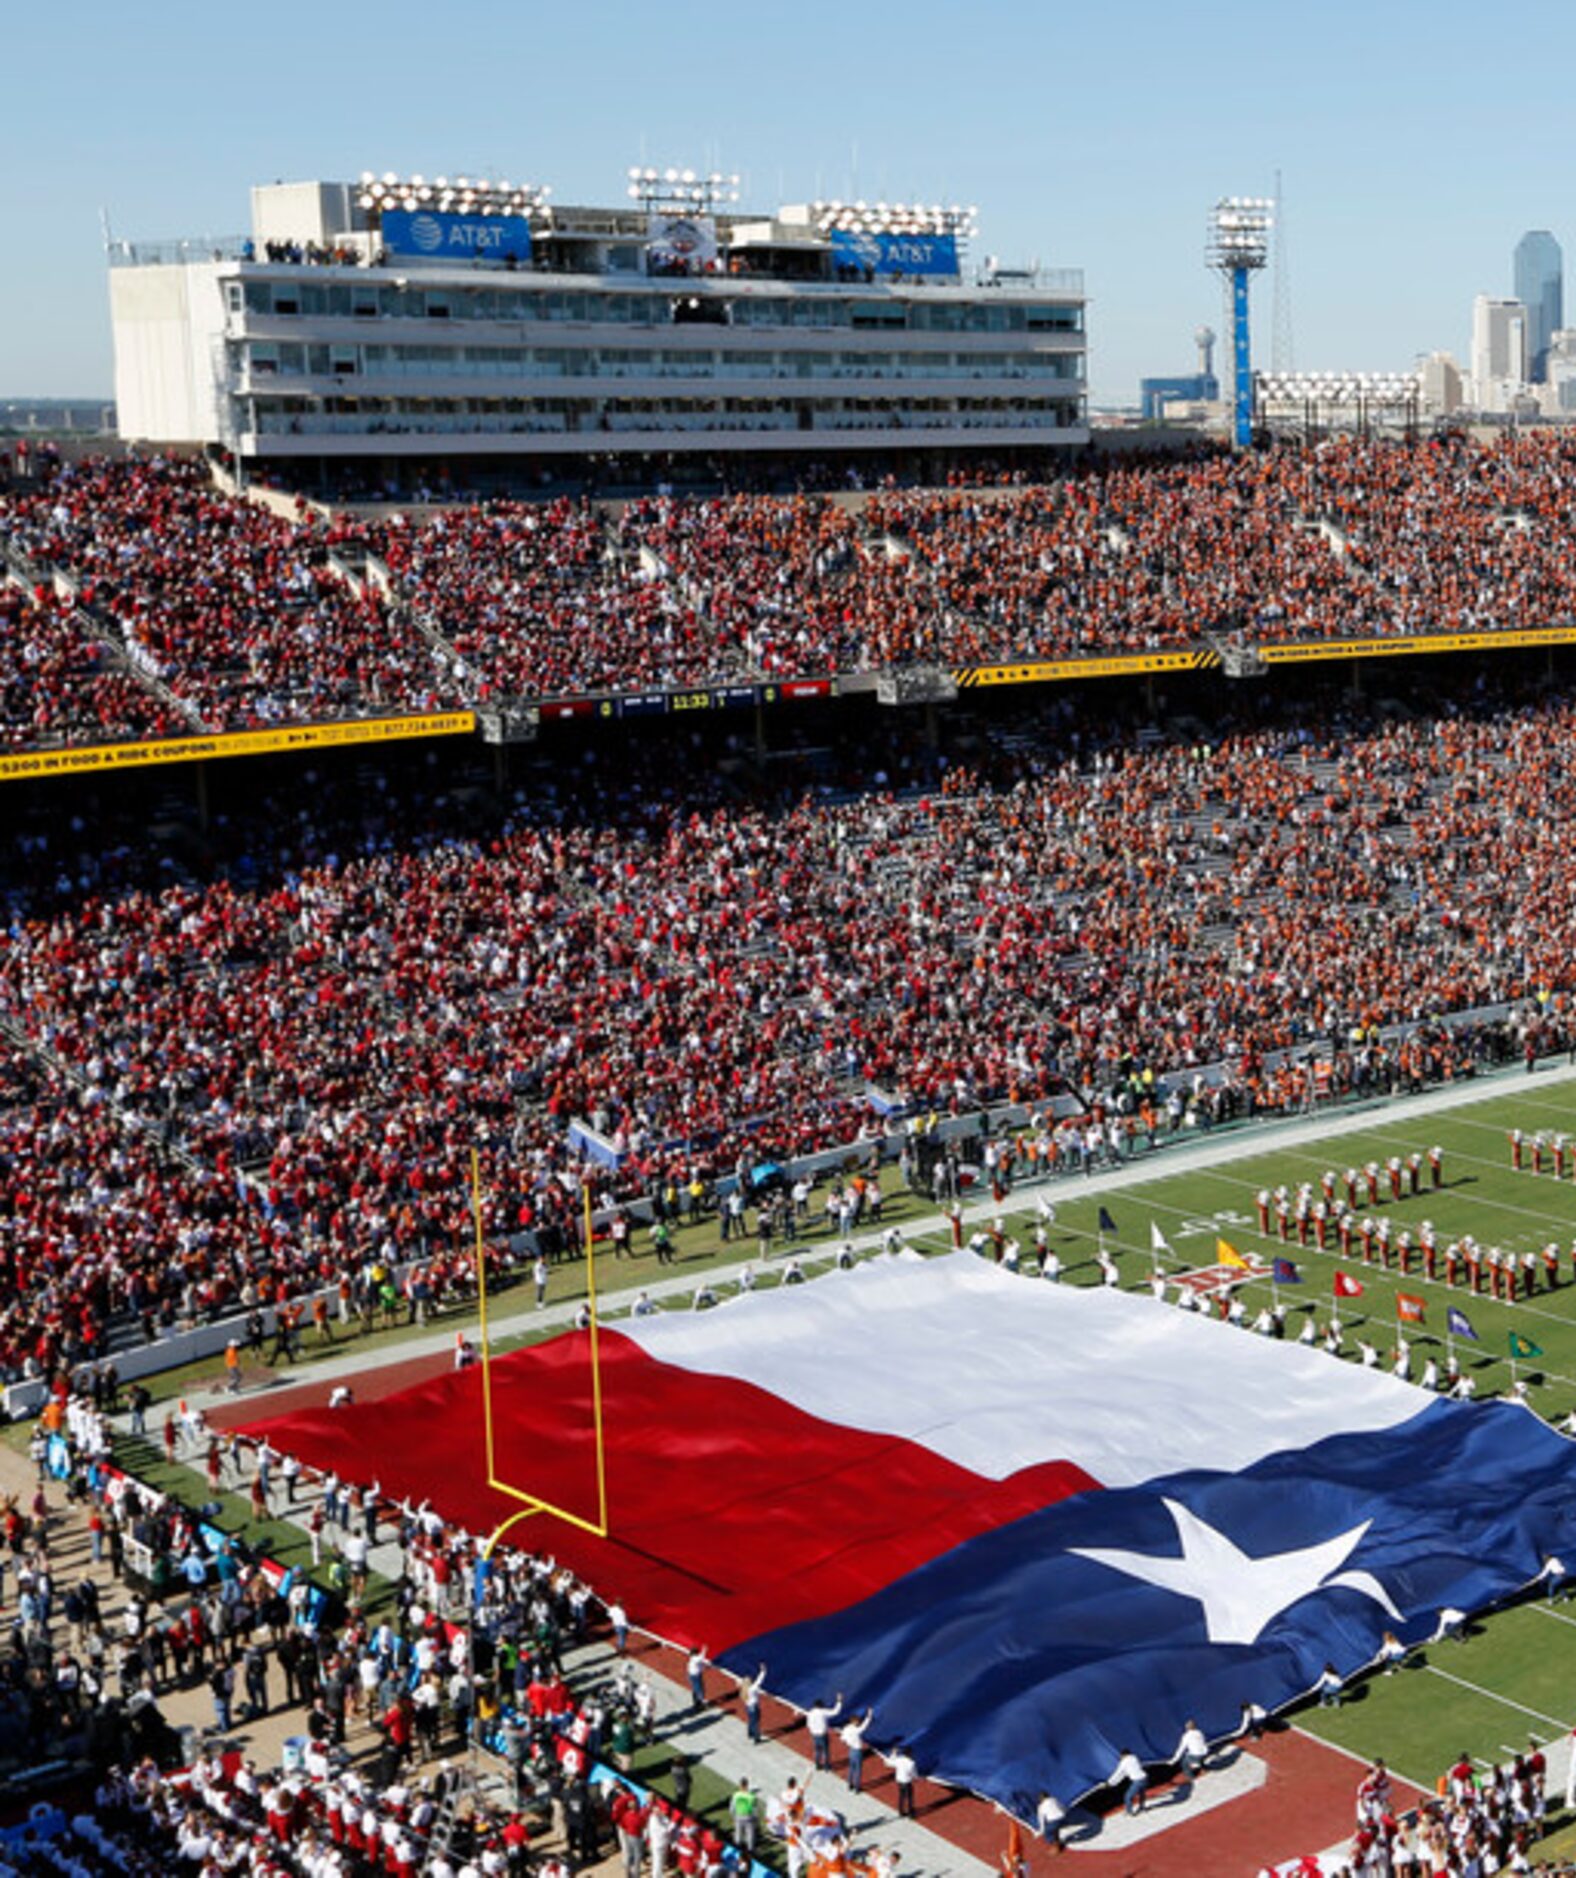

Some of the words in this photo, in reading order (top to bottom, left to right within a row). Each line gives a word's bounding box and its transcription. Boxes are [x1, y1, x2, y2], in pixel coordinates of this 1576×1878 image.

[449, 223, 503, 247] AT&T
[887, 244, 934, 263] AT&T
[61, 753, 99, 767] FOOD
[117, 748, 148, 761] RIDE
[153, 742, 216, 758] COUPONS
